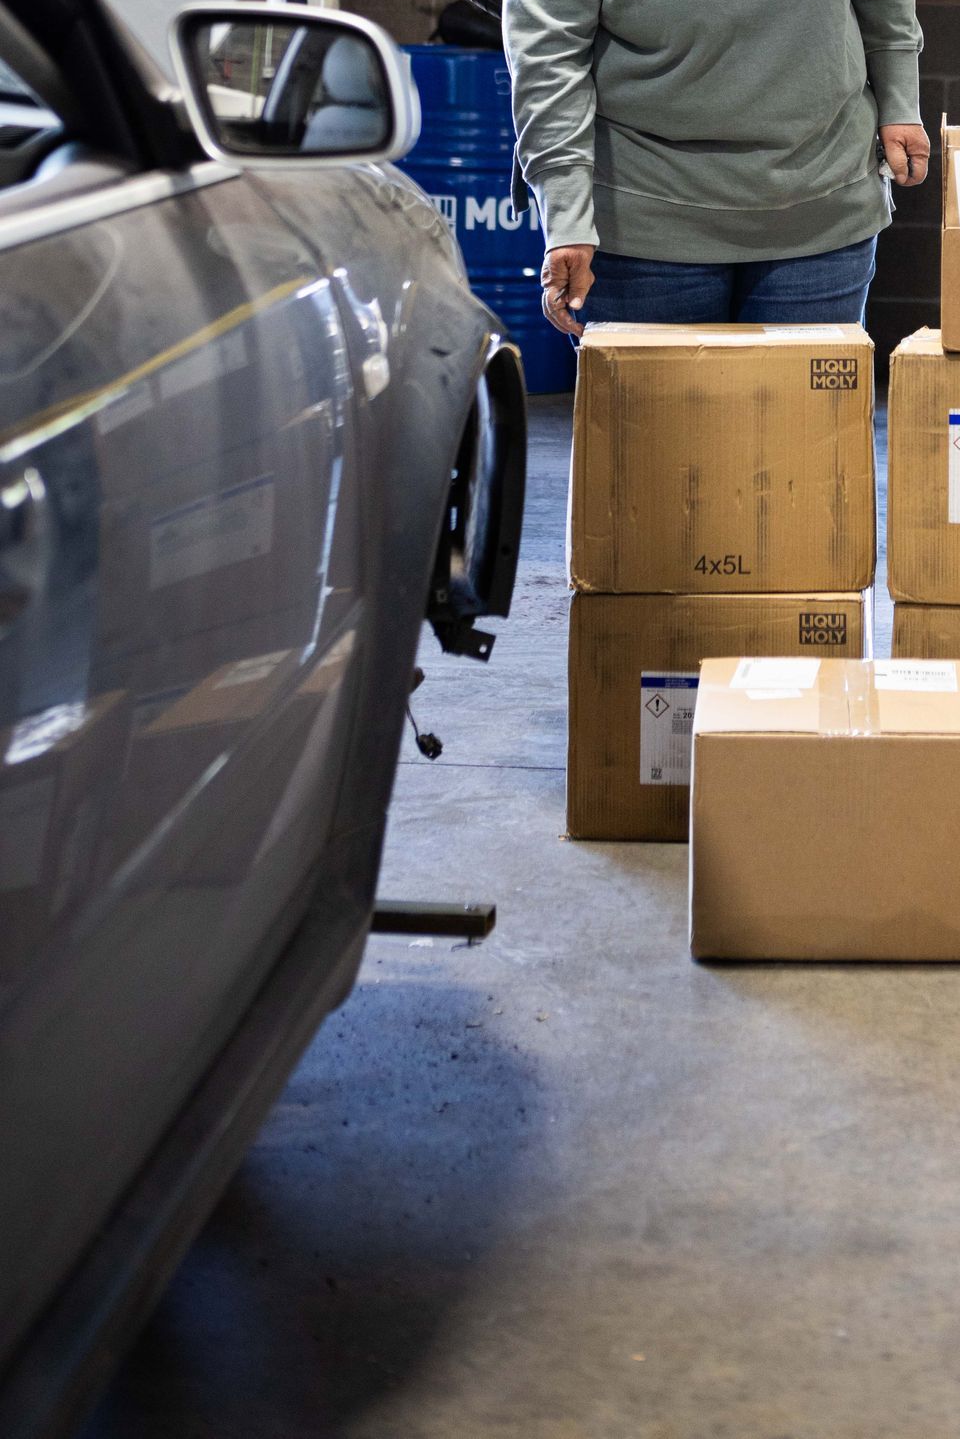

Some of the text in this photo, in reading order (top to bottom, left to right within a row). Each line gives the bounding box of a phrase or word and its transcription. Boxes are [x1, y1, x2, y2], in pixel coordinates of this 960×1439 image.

[812, 359, 856, 373] LIQUI
[812, 375, 857, 389] MOLY
[694, 555, 751, 576] 4x5L
[801, 614, 845, 629] LIQUI
[801, 630, 846, 644] MOLY
